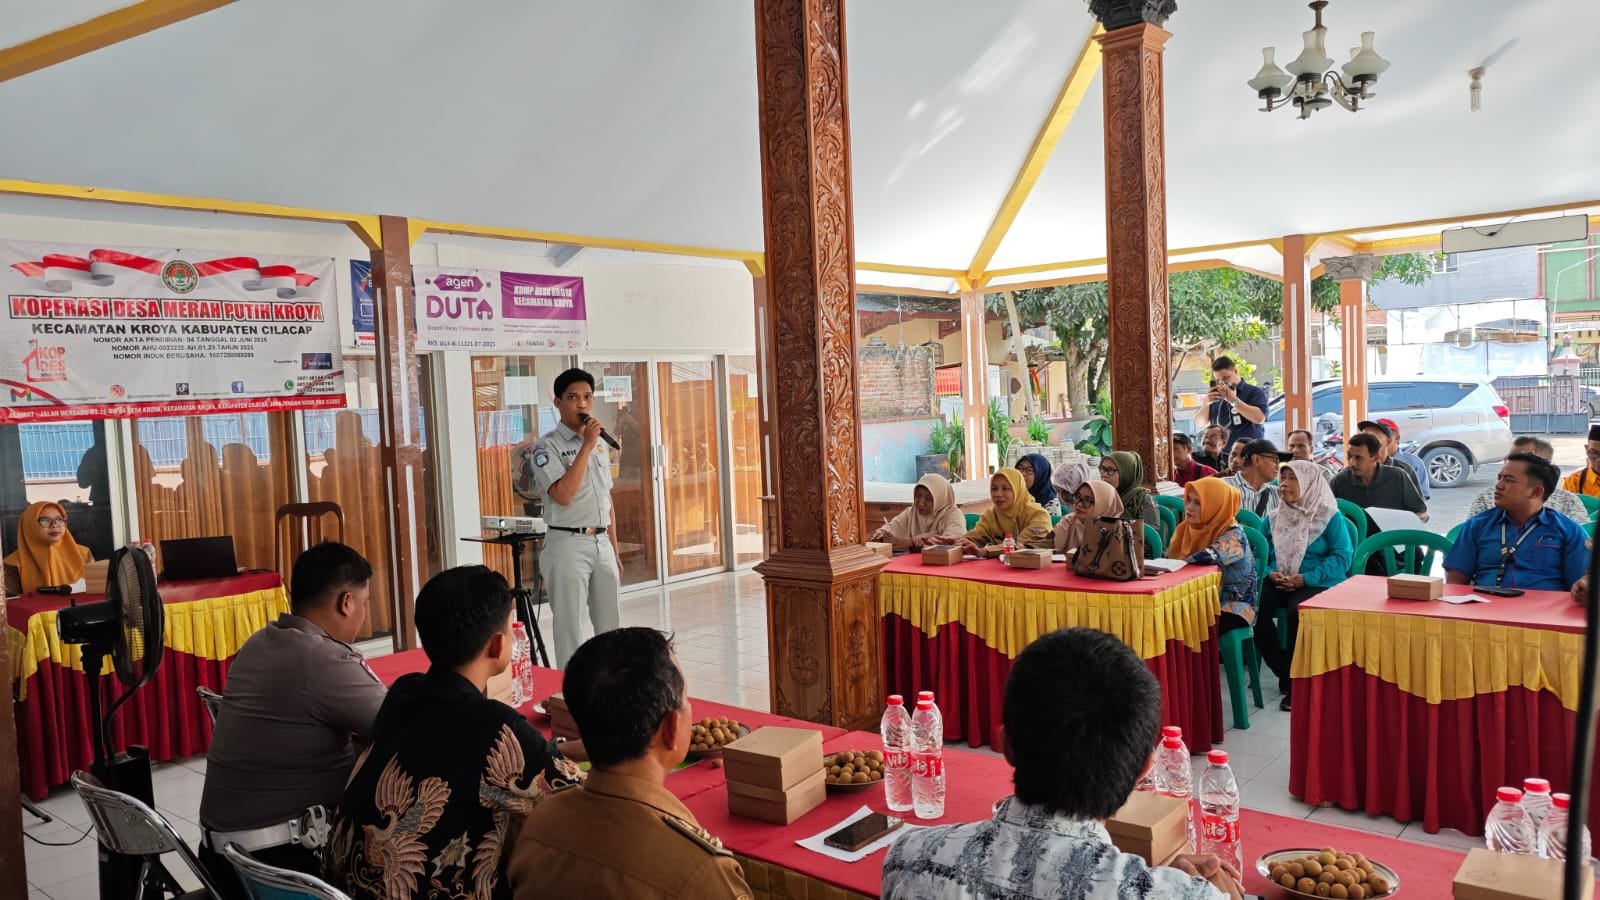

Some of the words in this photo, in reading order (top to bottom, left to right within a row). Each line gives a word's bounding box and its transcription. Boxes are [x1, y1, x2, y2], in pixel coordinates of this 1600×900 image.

[446, 278, 474, 289] agen
[11, 296, 109, 317] KOPERASI
[113, 299, 161, 318] DESA
[162, 300, 221, 319] MERAH
[223, 302, 271, 320] PUTIH
[273, 303, 322, 320] KROYA
[426, 295, 493, 320] DUTA
[32, 323, 126, 335] KECAMATAN
[131, 324, 177, 335] KROYA
[181, 325, 257, 335] KABUPATEN
[262, 326, 312, 335] CILACAP
[39, 346, 65, 360] KOP
[40, 360, 66, 372] DES
